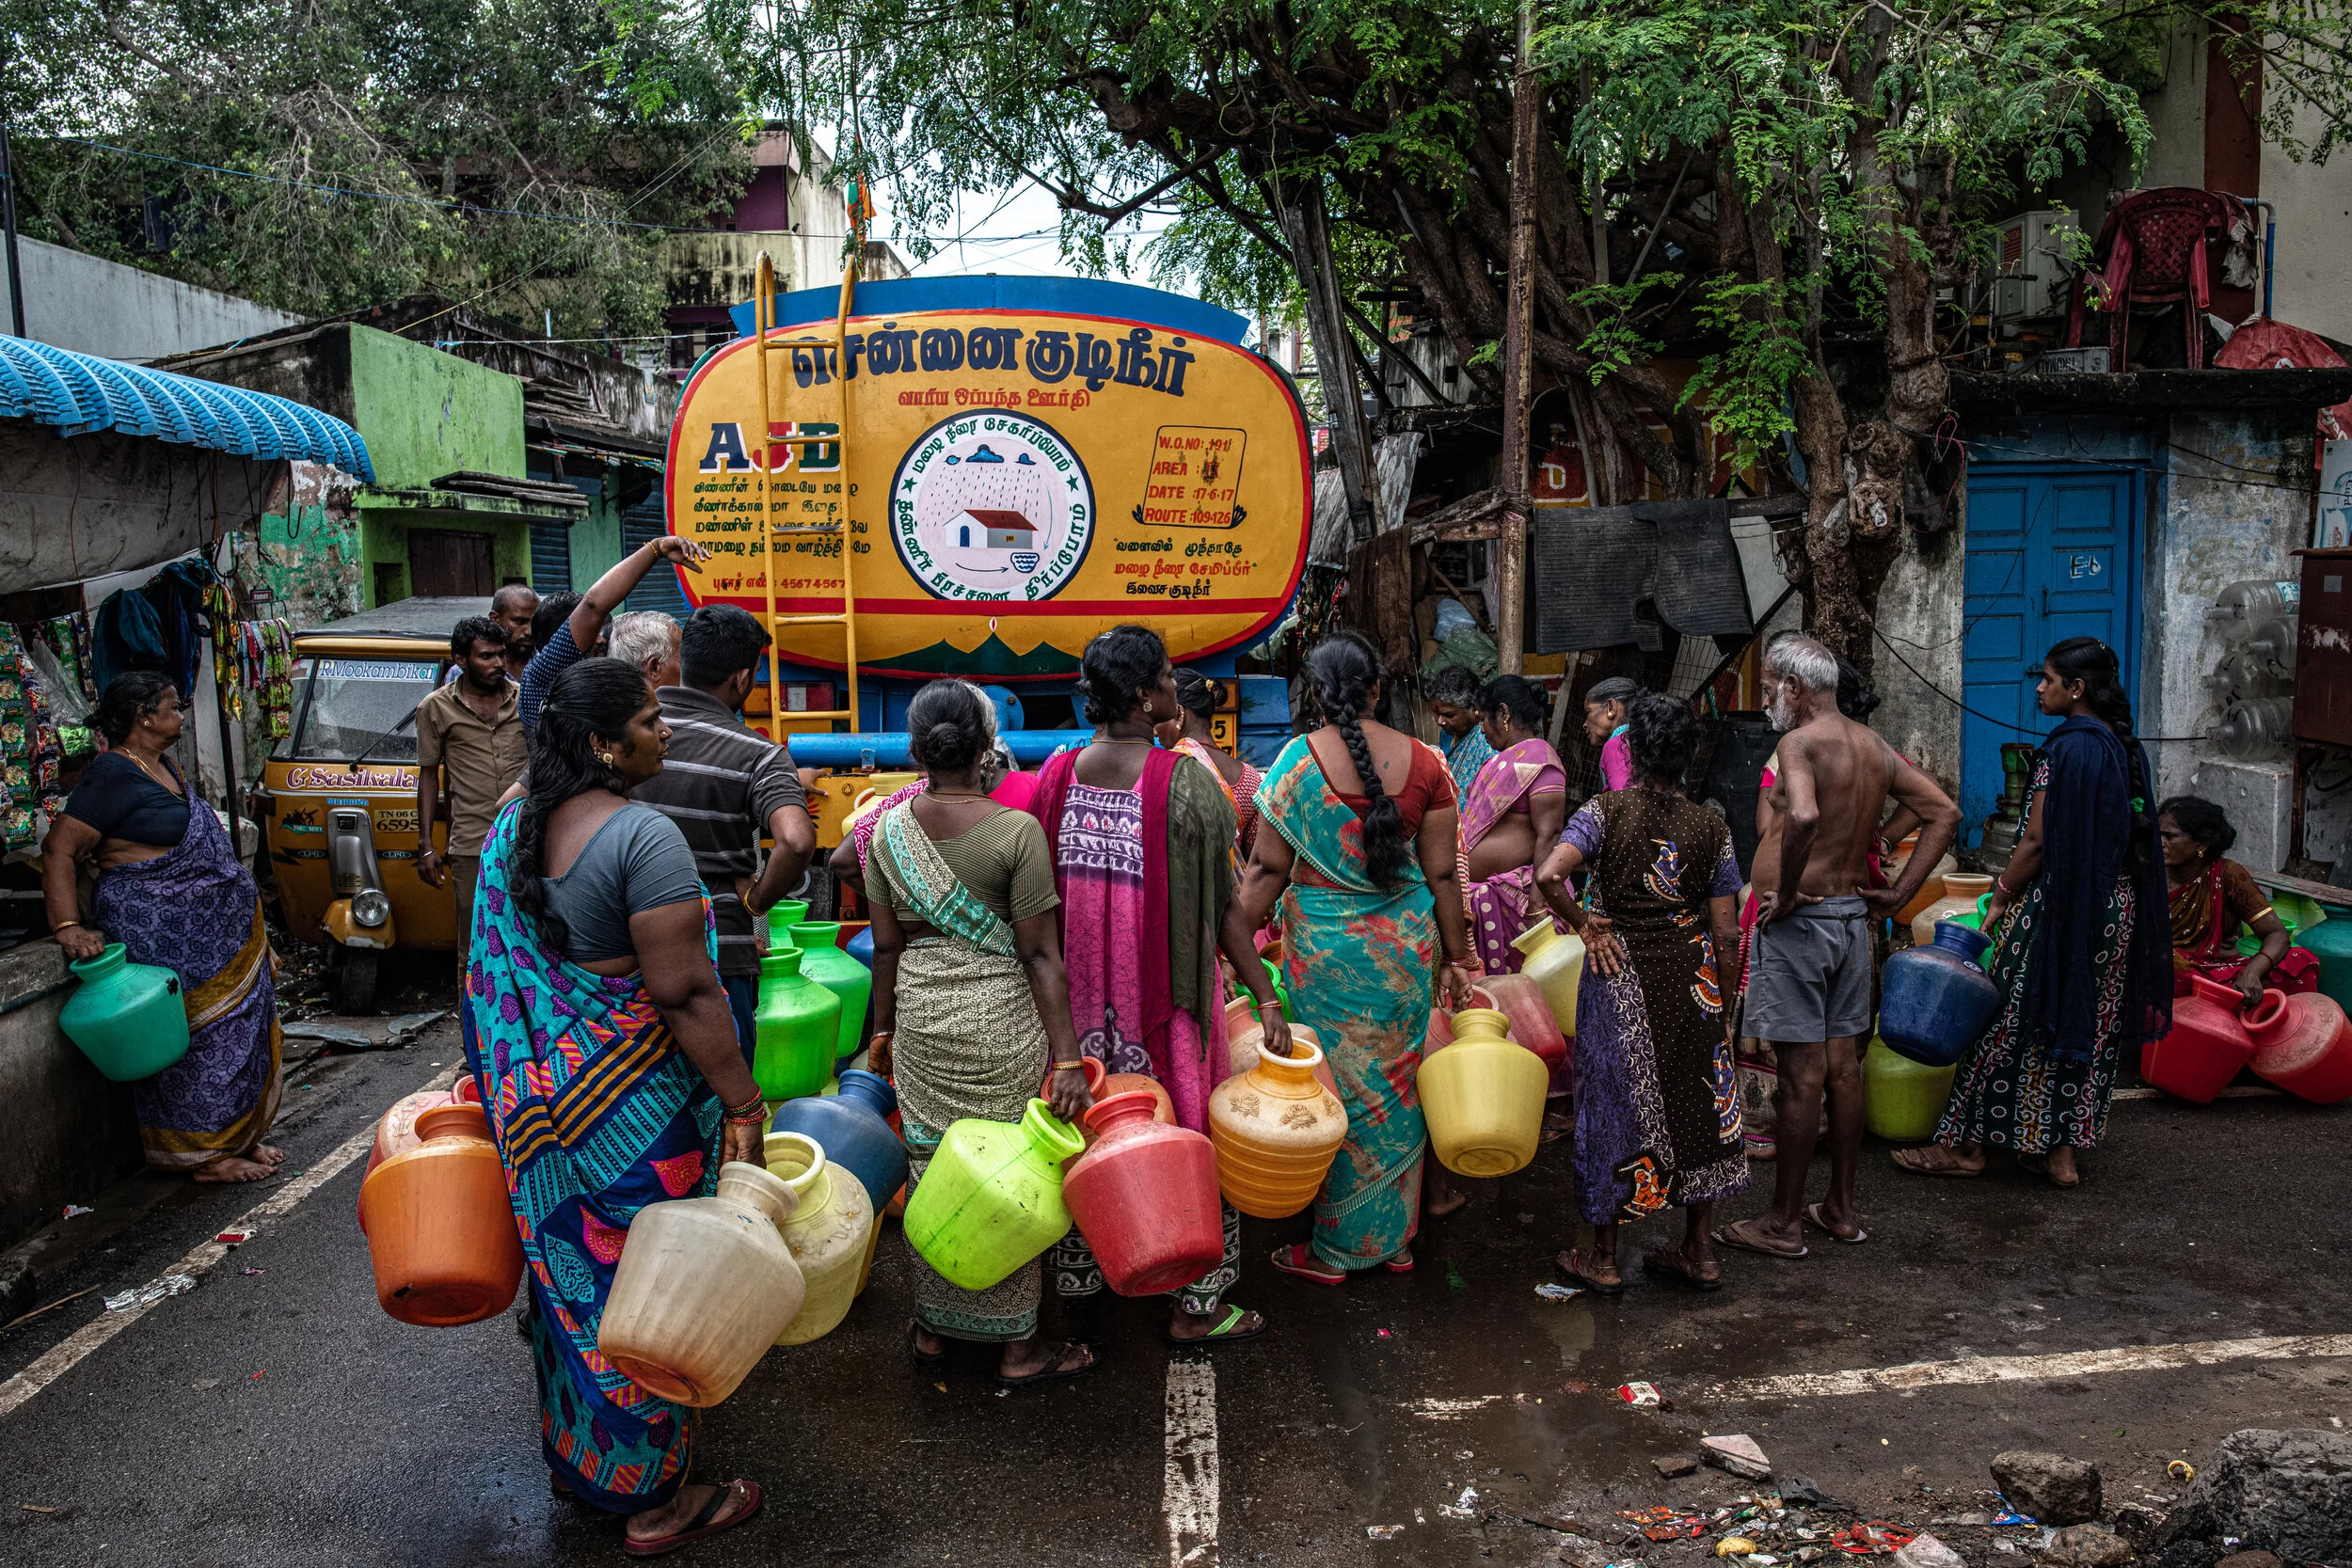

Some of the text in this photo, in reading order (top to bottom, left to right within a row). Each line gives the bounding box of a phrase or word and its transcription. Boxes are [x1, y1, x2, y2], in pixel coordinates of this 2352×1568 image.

[898, 387, 1090, 412] வாரிய ஒப்பந்த ஊர்தி
[912, 437, 945, 474] மழை
[946, 419, 978, 444] நீரை
[1152, 461, 1187, 476] AREA
[1148, 485, 1185, 499] DATE
[1144, 508, 1188, 524] ROUTE
[896, 499, 934, 572] தண்ணீர்
[1114, 562, 1151, 578] மழை
[1152, 558, 1185, 579] நீரை
[378, 810, 394, 818] TN
[395, 810, 408, 818] 06
[376, 818, 420, 832] 6595
